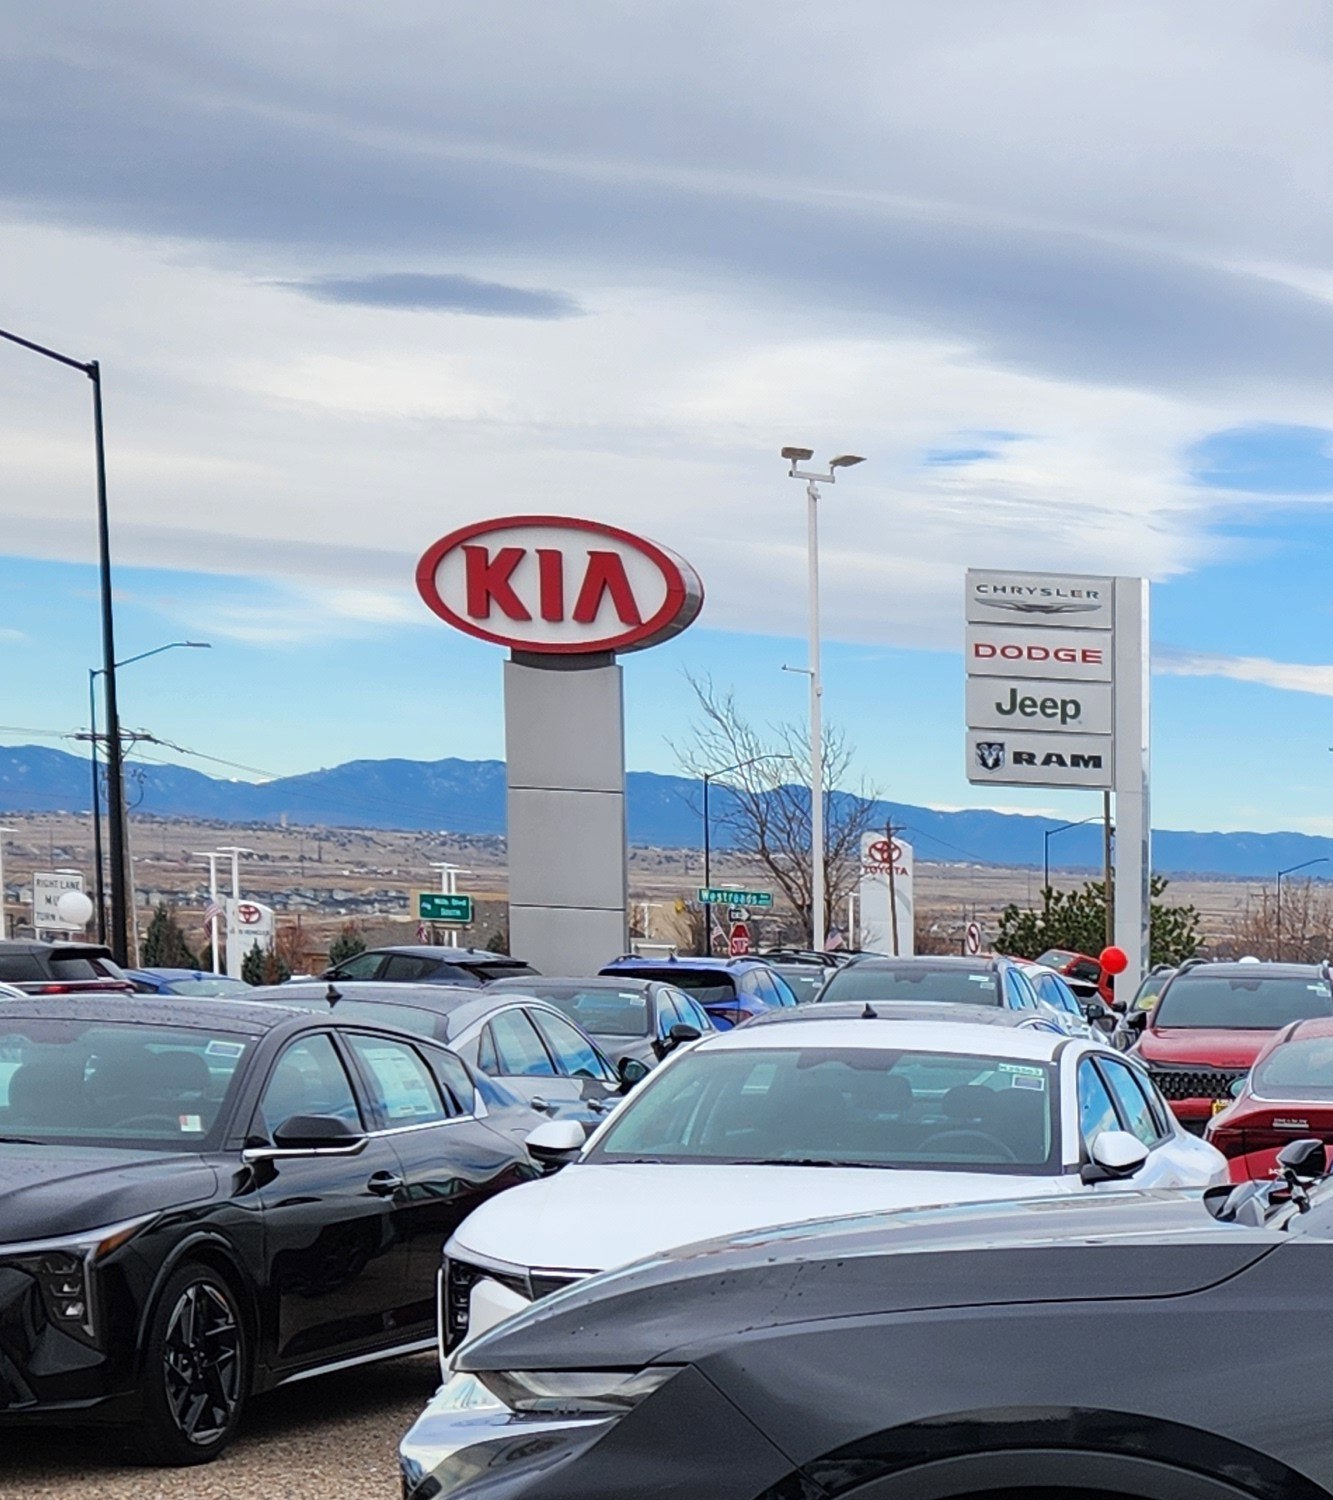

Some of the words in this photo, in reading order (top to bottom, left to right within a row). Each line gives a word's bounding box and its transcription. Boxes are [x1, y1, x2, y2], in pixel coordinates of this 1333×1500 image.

[461, 545, 643, 626] KIA
[976, 584, 1100, 599] CHRYSLER
[974, 643, 1103, 664] DODGE
[995, 688, 1081, 725] Jeep
[1012, 751, 1102, 769] RAM
[863, 865, 909, 876] TOYOTA
[60, 881, 80, 890] LANE
[732, 937, 749, 954] STOP
